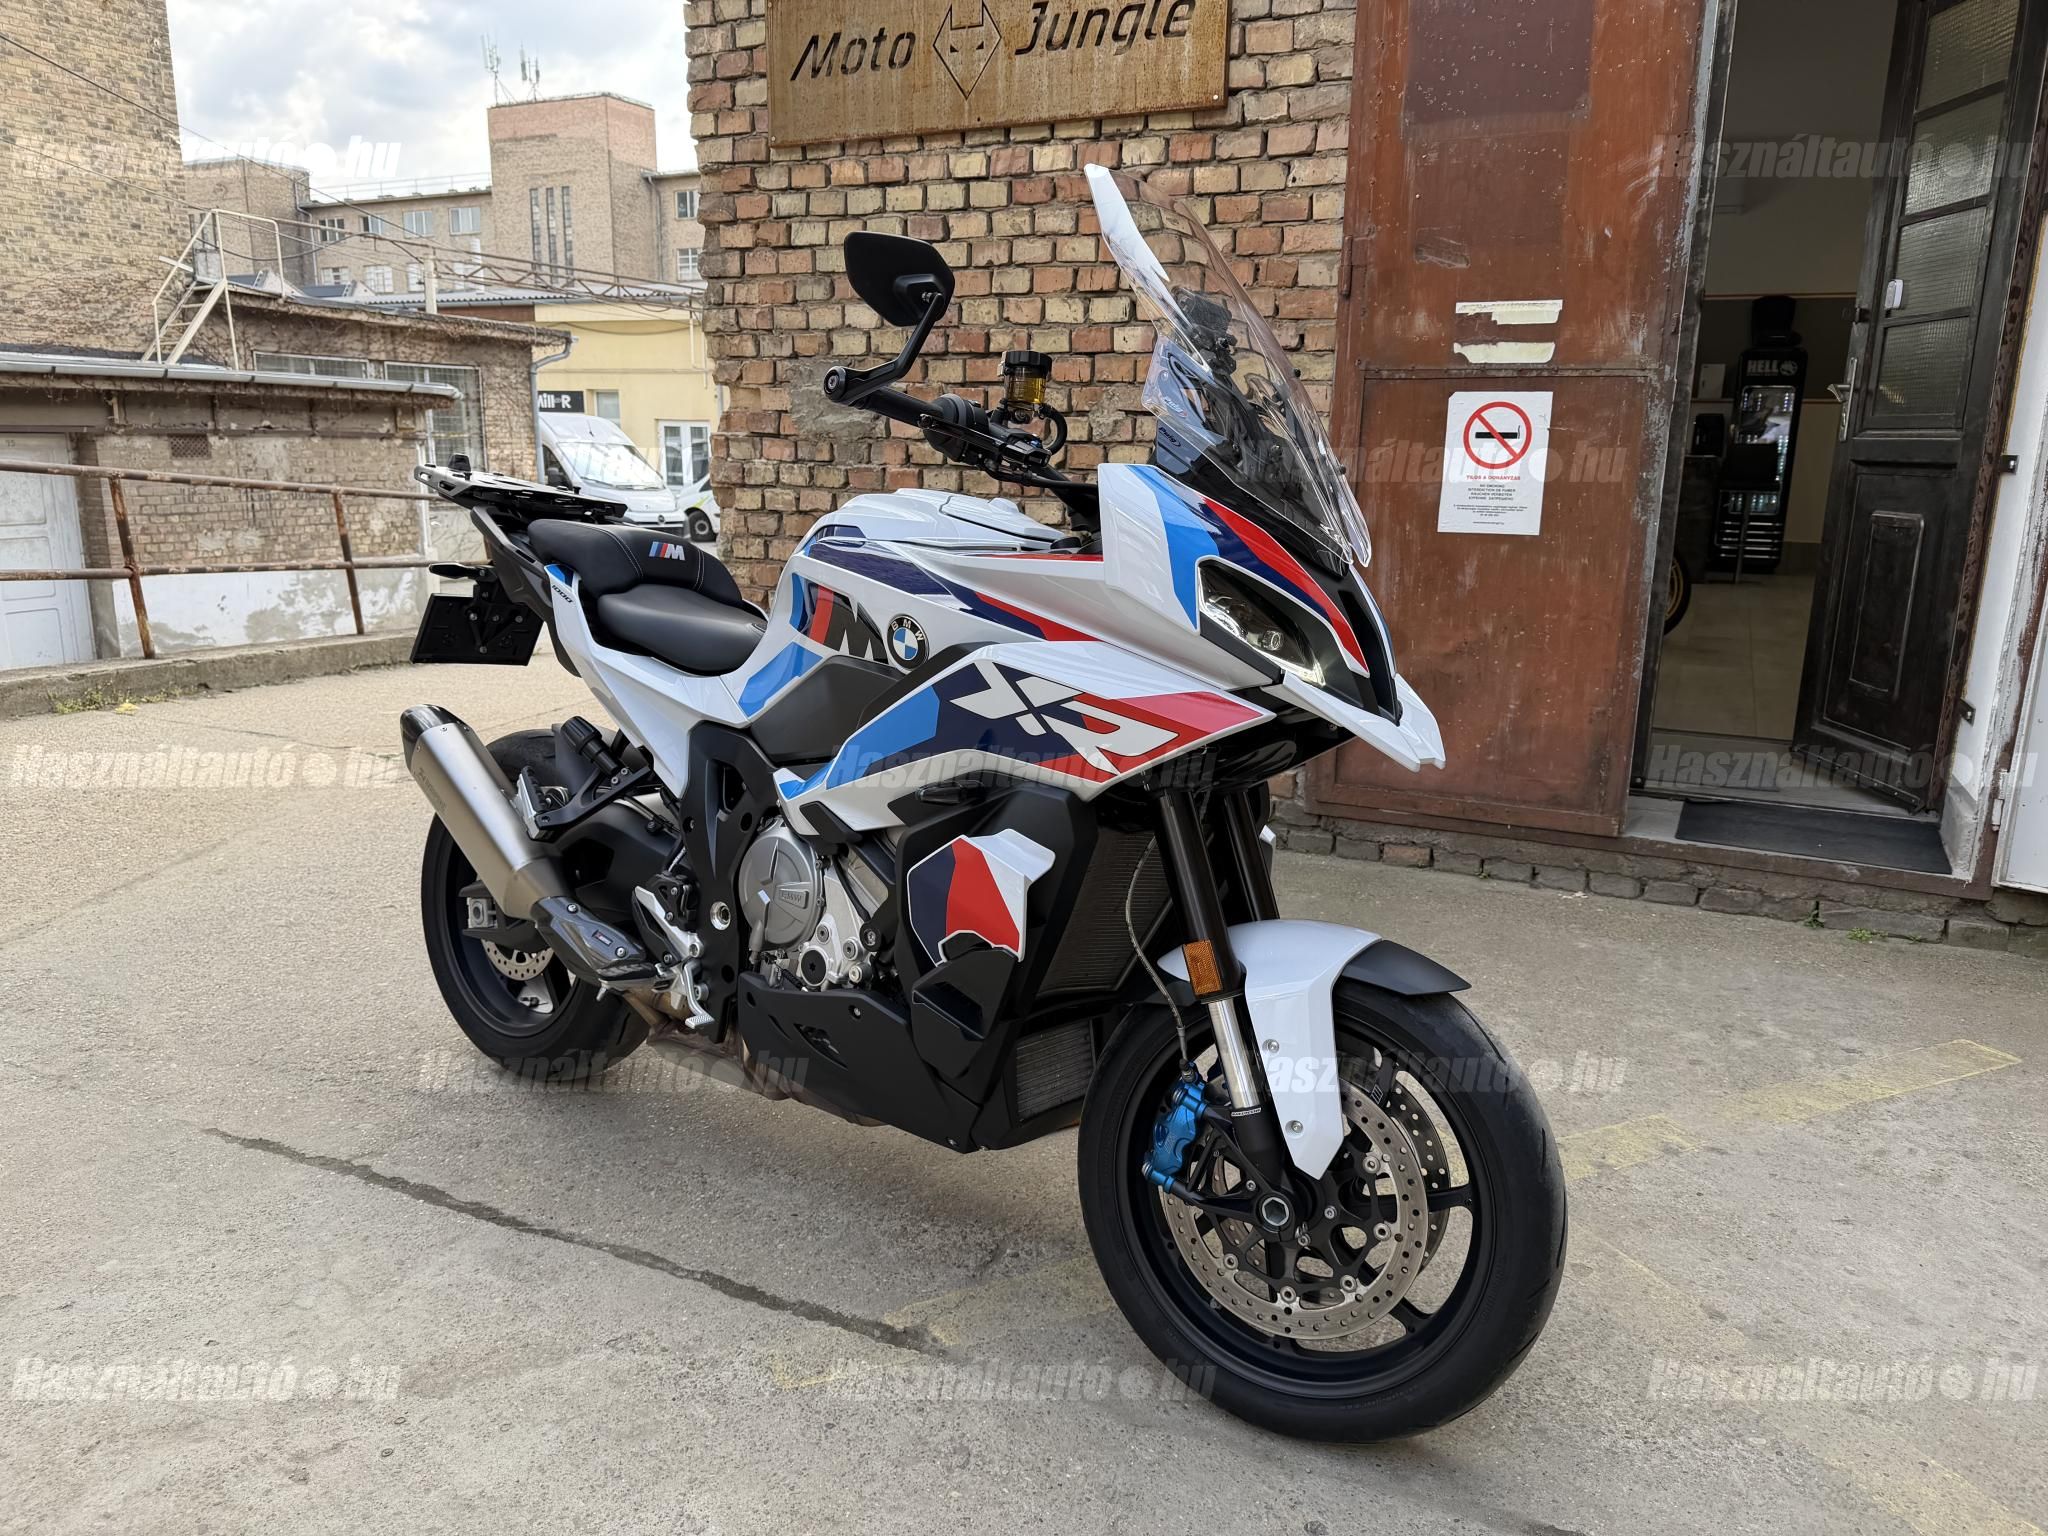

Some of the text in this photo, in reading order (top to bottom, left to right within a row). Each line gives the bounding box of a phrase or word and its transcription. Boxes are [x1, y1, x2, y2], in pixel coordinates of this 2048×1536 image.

[789, 0, 1197, 82] Moto Jungle
[1746, 359, 1779, 373] HELL
[551, 584, 575, 604] 1000
[890, 618, 925, 641] BMW
[949, 660, 1180, 776] XR
